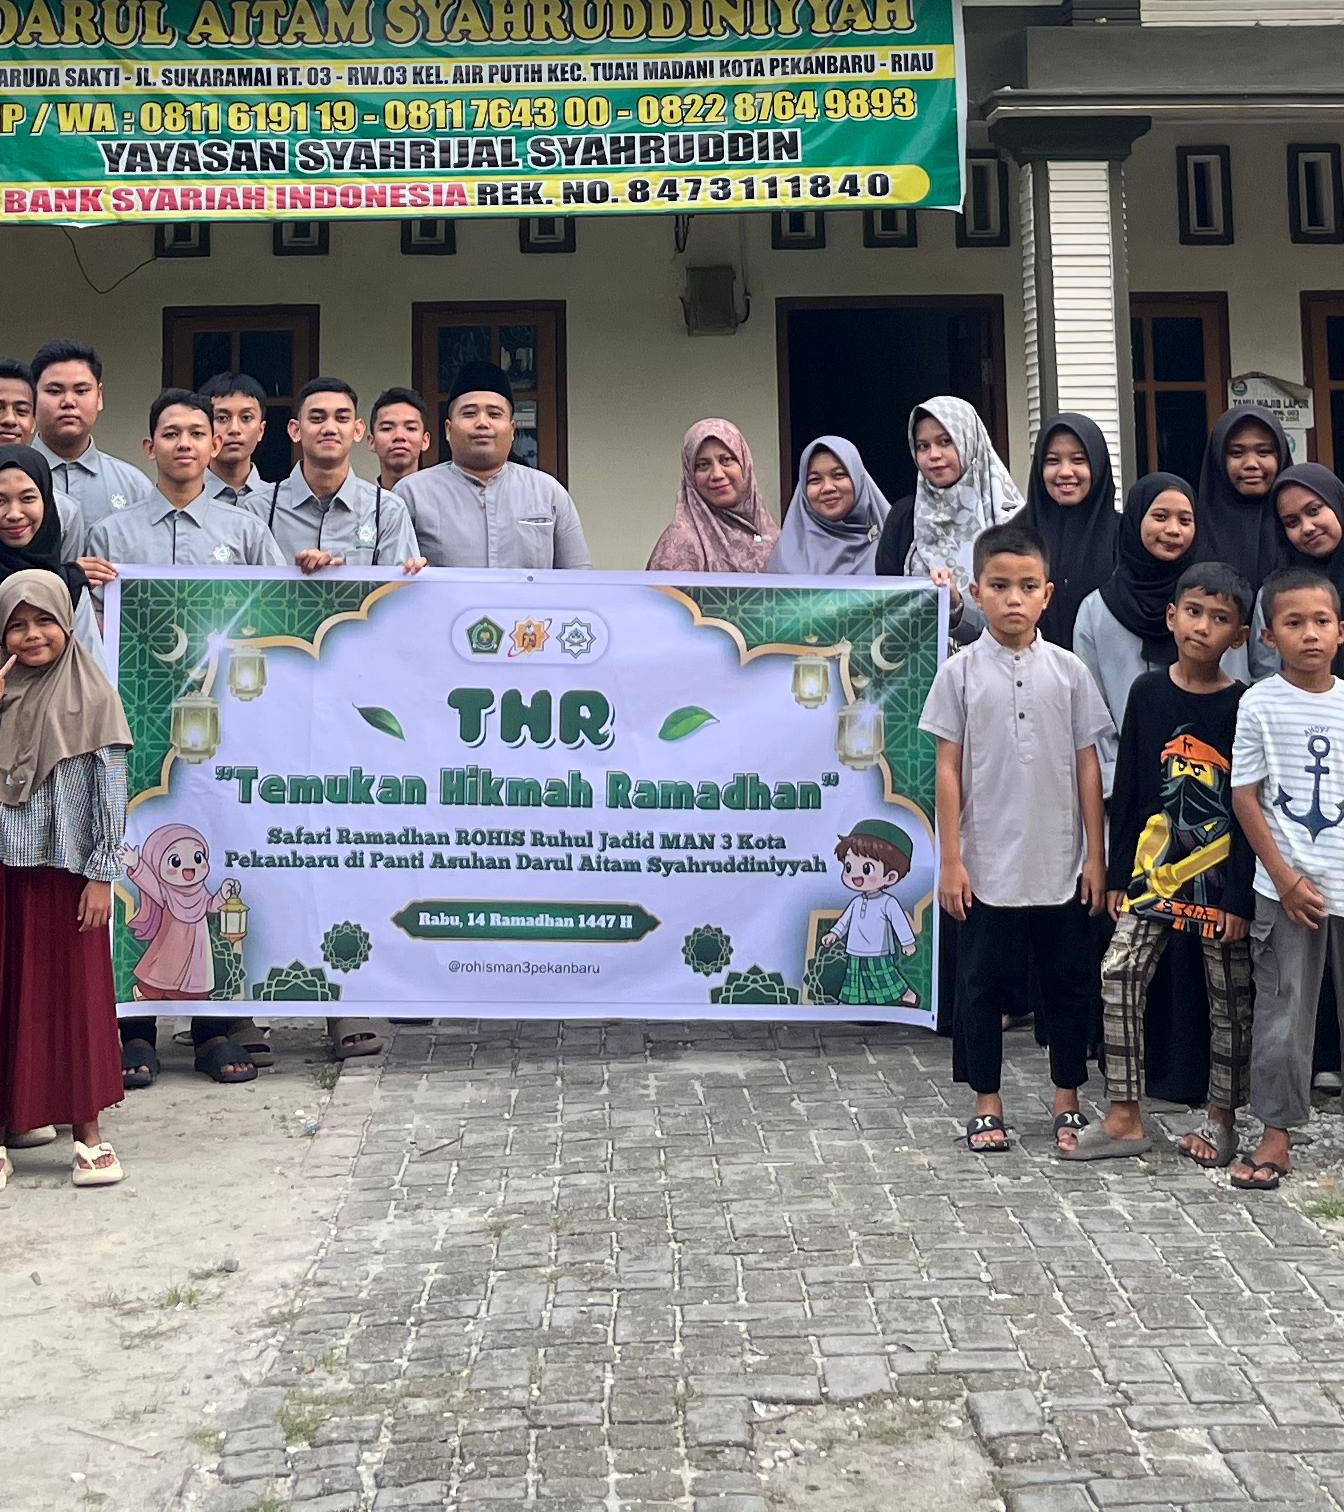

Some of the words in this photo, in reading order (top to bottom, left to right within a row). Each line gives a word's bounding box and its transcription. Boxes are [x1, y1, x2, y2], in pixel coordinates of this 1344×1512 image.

[65, 67, 120, 87] SAKTI
[136, 67, 157, 87] JL.
[161, 67, 273, 88] SUKARAMAI
[277, 67, 303, 86] RT.
[307, 66, 332, 86] 03
[347, 65, 408, 86] RW.03
[412, 65, 449, 85] KEL.
[452, 64, 484, 84] AIR
[488, 64, 543, 84] PUTIH
[547, 63, 587, 83] KEC.
[590, 62, 639, 82] TUAH
[643, 59, 714, 81] MADANI
[719, 58, 765, 78] KOTA
[769, 54, 876, 76] PEKANBARU
[891, 52, 935, 73] RIAU
[30, 102, 55, 136] /
[57, 102, 120, 134] WA
[140, 100, 222, 134] 0811
[228, 100, 309, 133] 6191
[316, 99, 359, 133] 19
[383, 97, 462, 132] 0811
[470, 97, 558, 129] 7643
[563, 95, 611, 128] 00
[637, 92, 728, 126] 0822
[734, 90, 818, 124] 8764
[824, 88, 918, 121] 9893
[99, 140, 290, 176] YAYASAN
[296, 136, 523, 173] SYAHRIJAL
[528, 128, 802, 168] SYAHRUDDIN
[2, 187, 103, 215] BANK
[111, 184, 269, 213] SYARIAH
[275, 182, 470, 212] INDONESIA
[477, 181, 554, 206] REK.
[562, 179, 619, 205] NO.
[628, 173, 891, 204] 8473111840
[1257, 399, 1281, 409] WAJIB
[1283, 399, 1309, 409] LAPOR
[447, 687, 616, 751] THR
[439, 764, 593, 808] Hikmah
[267, 826, 332, 846] Safari
[336, 826, 450, 846] Ramadhan
[455, 828, 526, 846] ROHIS
[530, 829, 594, 848] Ruhul
[598, 831, 655, 852] Jadid
[659, 833, 716, 850] MAN
[721, 834, 732, 850] 3
[737, 834, 786, 850] Kota
[224, 850, 339, 869] Pekanbaru
[344, 850, 366, 868] di
[370, 851, 424, 869] Panti
[429, 852, 511, 870] Asuhan
[515, 853, 573, 871] Darul
[577, 854, 642, 873] Aitam
[646, 854, 827, 876] Syahruddiniyyah
[418, 912, 463, 928] Rabu,
[467, 913, 485, 926] 14
[489, 913, 574, 928] Ramadhan
[578, 914, 615, 928] 1447
[619, 915, 633, 928] H
[448, 959, 600, 975] @rohisman3pekanbaru
